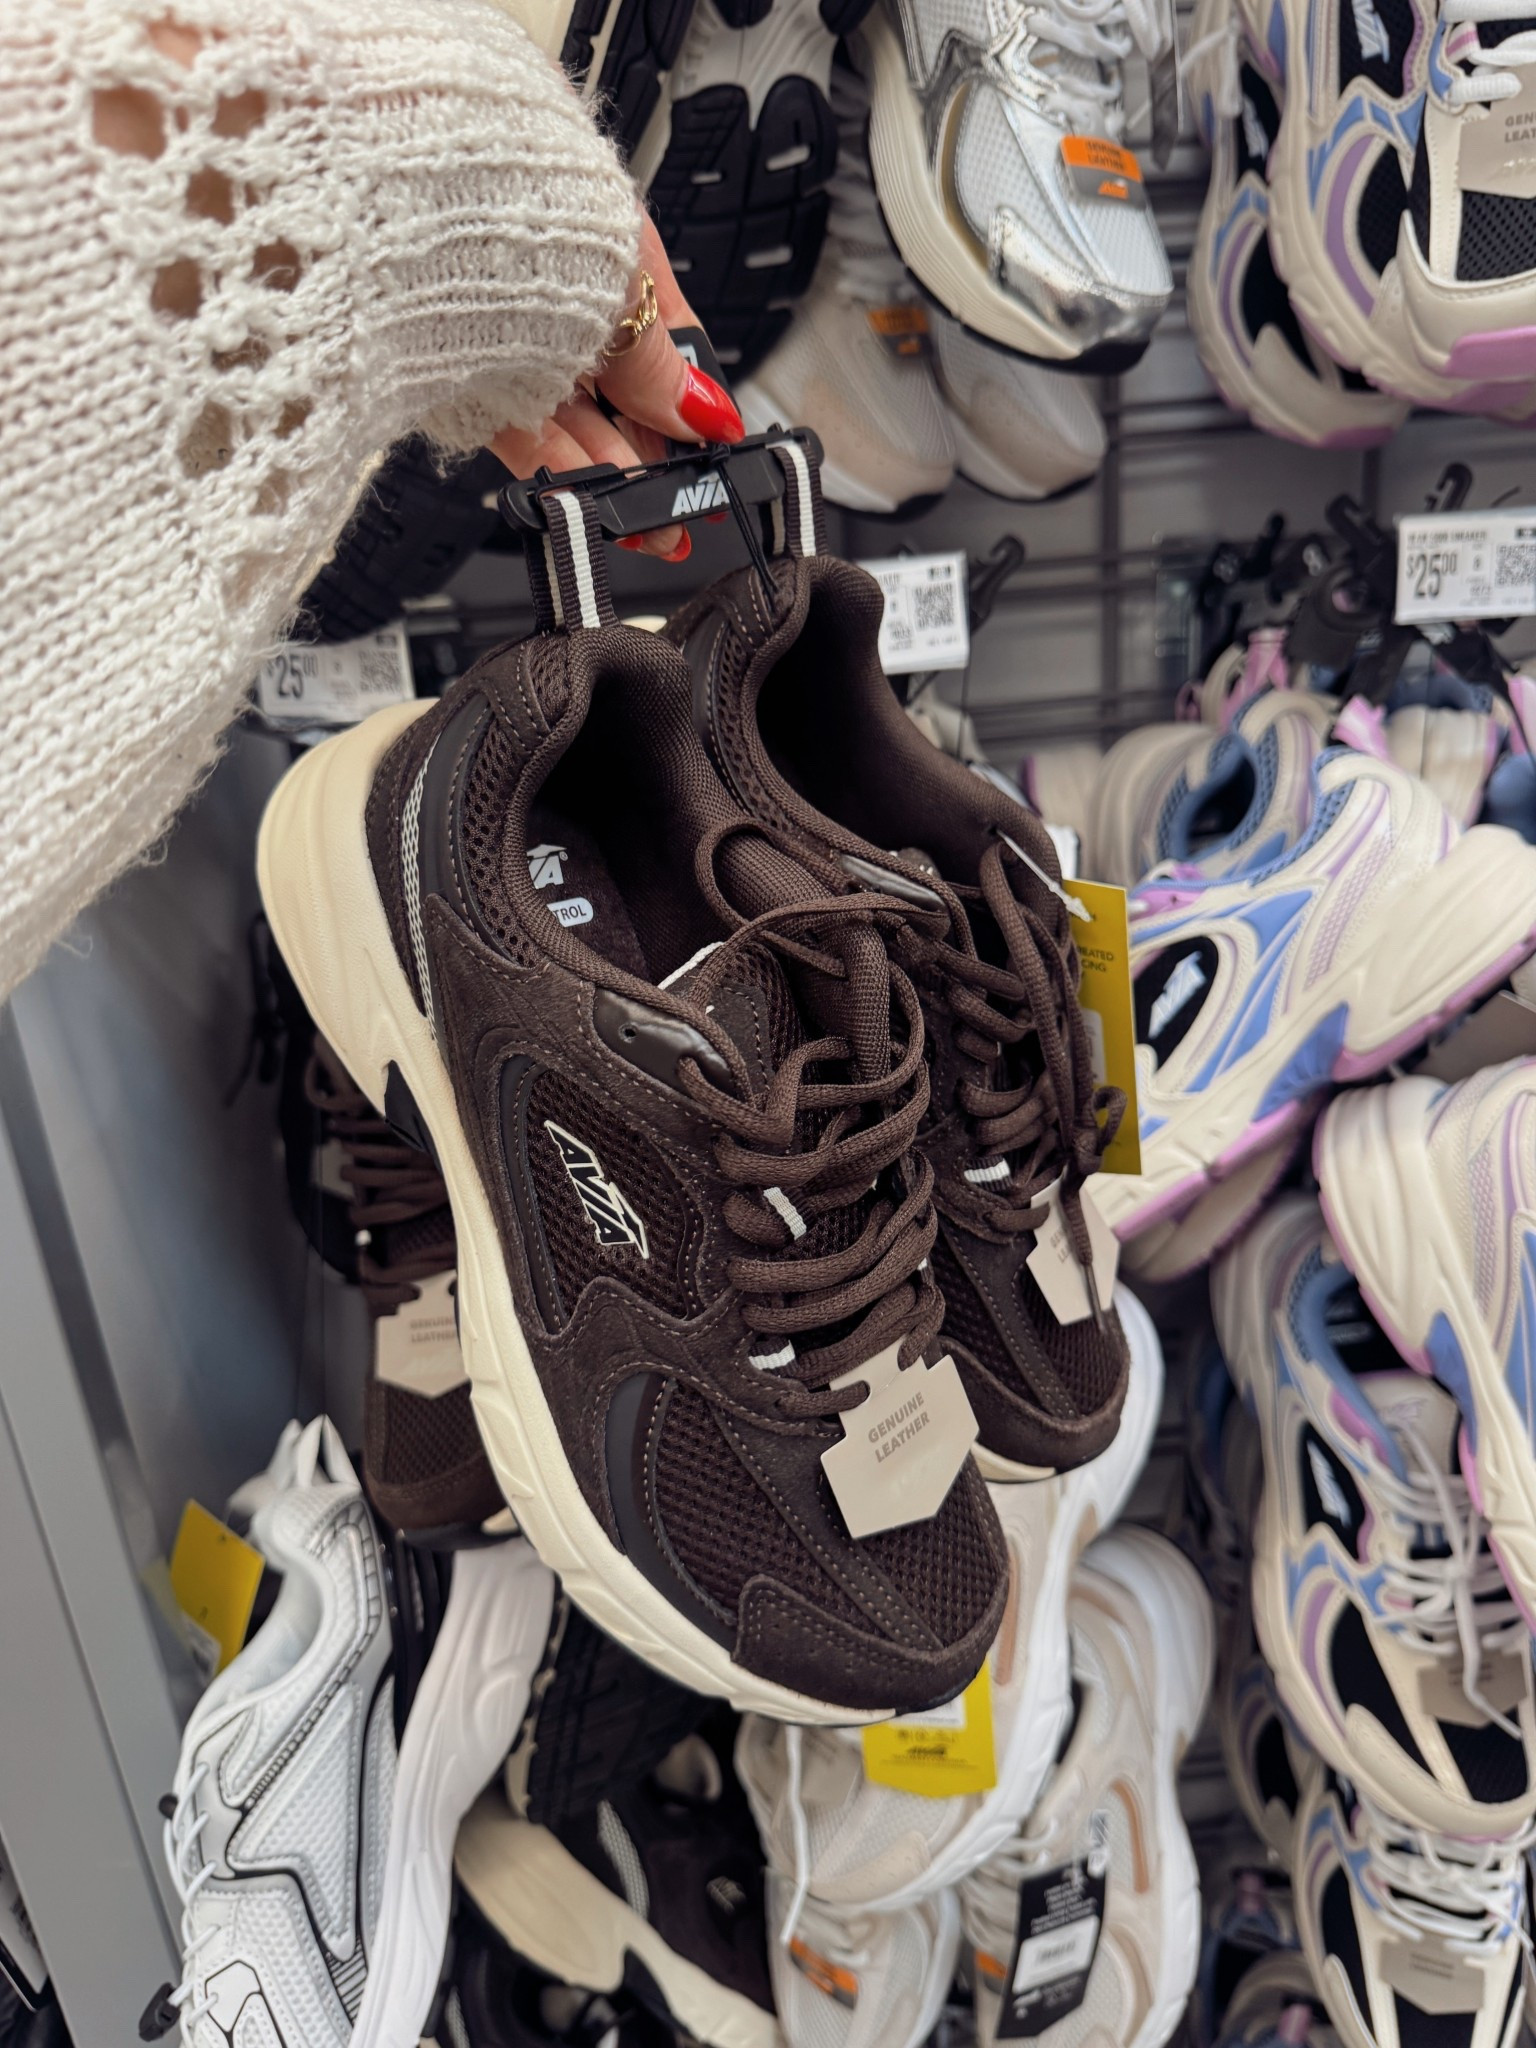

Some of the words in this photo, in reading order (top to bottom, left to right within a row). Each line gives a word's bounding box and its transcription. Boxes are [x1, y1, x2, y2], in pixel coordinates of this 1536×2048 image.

[1505, 112, 1536, 127] GEN
[671, 470, 730, 518] AVIA
[544, 1119, 650, 1260] AVIA
[867, 1391, 925, 1444] GENUINE
[873, 1411, 931, 1464] LEATHER
